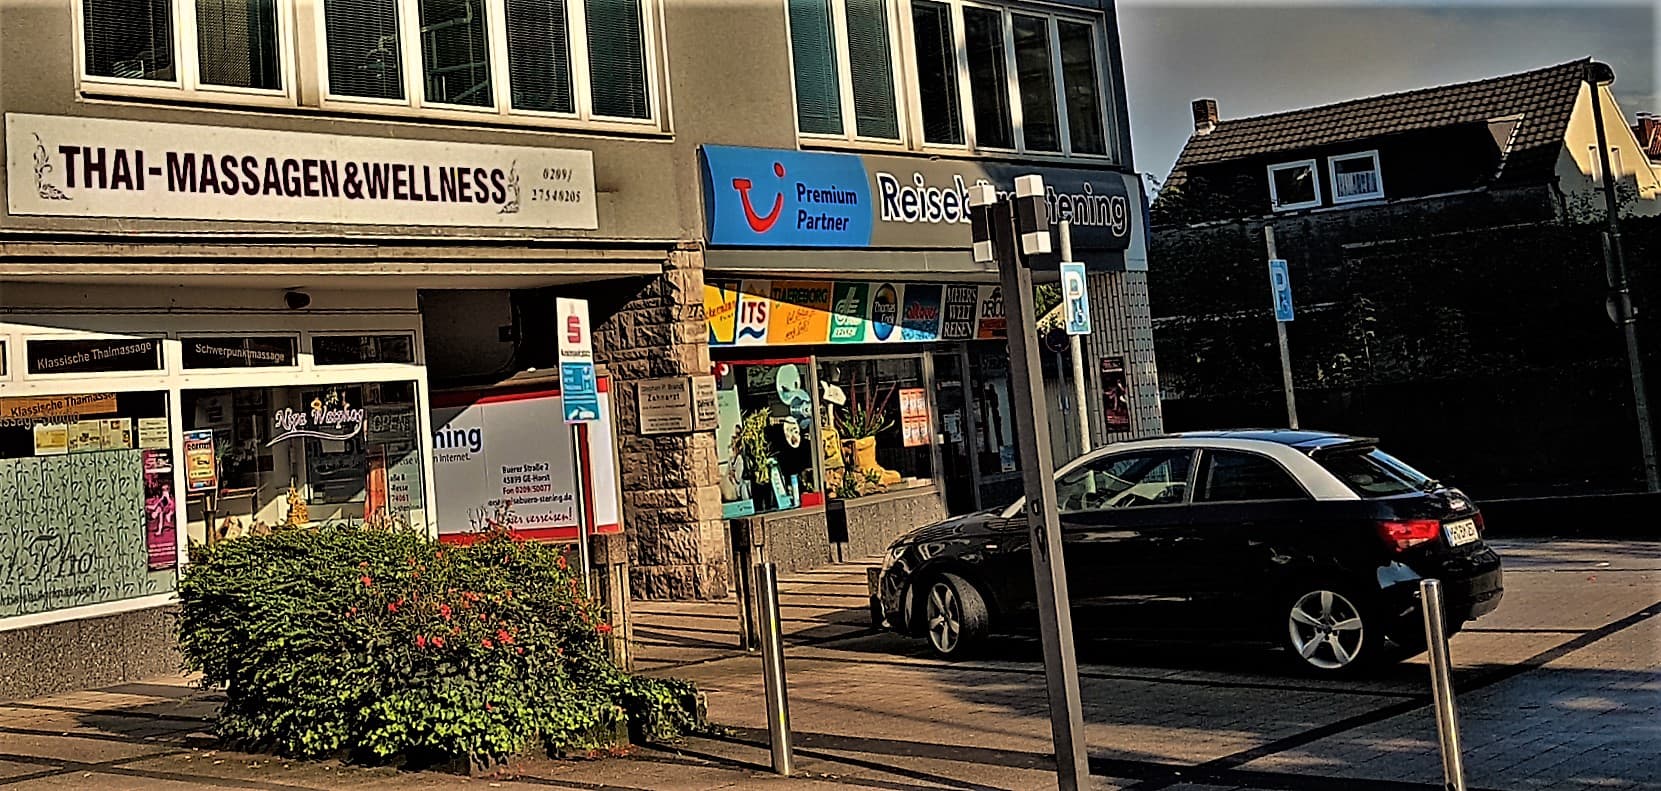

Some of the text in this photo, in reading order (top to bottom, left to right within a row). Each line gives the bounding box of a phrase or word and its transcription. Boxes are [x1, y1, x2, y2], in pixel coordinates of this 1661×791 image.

[797, 182, 857, 204] Premium
[1045, 181, 1127, 238] tening
[798, 209, 849, 231] Partner
[741, 301, 766, 324] ITS
[874, 301, 896, 313] Thomas
[881, 312, 895, 325] Cook
[943, 321, 974, 338] REISEN
[37, 351, 90, 370] Klassische
[195, 343, 285, 362] Schwerpunktmassage
[10, 400, 63, 417] Klassische
[502, 487, 515, 495] Fon
